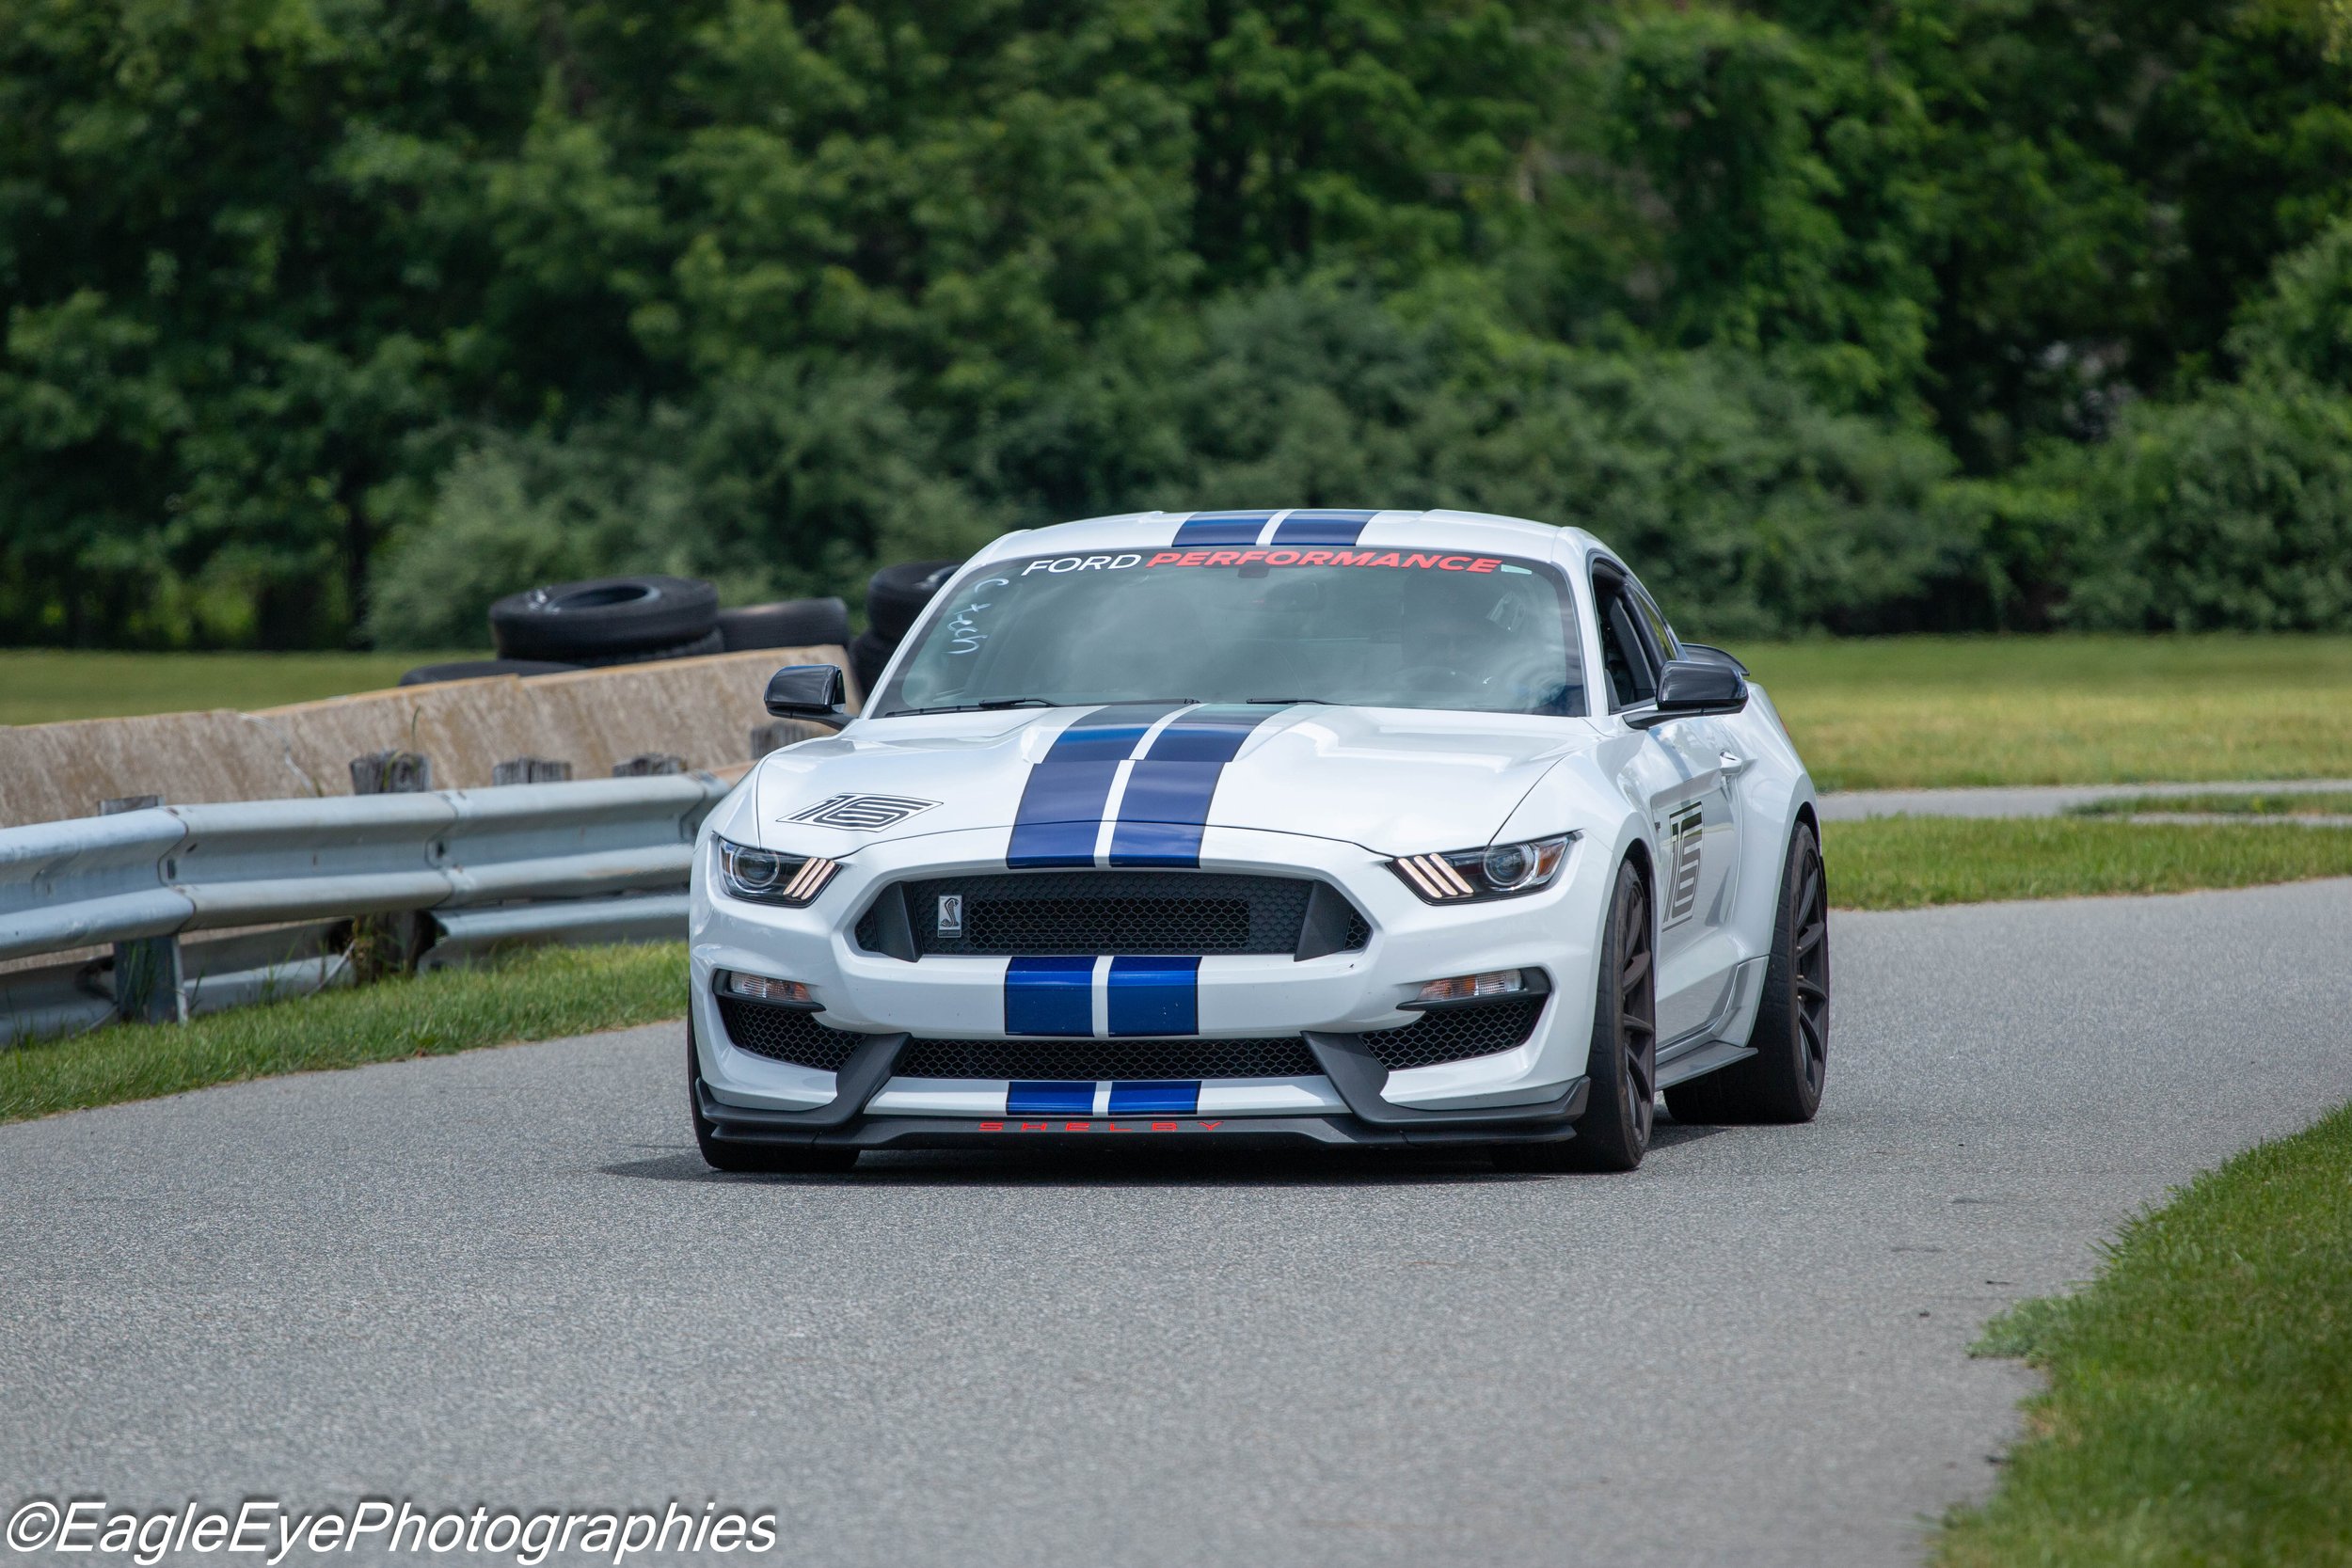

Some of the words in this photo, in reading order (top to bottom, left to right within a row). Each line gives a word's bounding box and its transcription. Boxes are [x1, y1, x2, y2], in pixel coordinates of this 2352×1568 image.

[1021, 553, 1142, 576] FORD
[1144, 550, 1503, 574] PERFORMANCE
[787, 795, 934, 828] 16
[977, 1121, 1223, 1132] SHELBY
